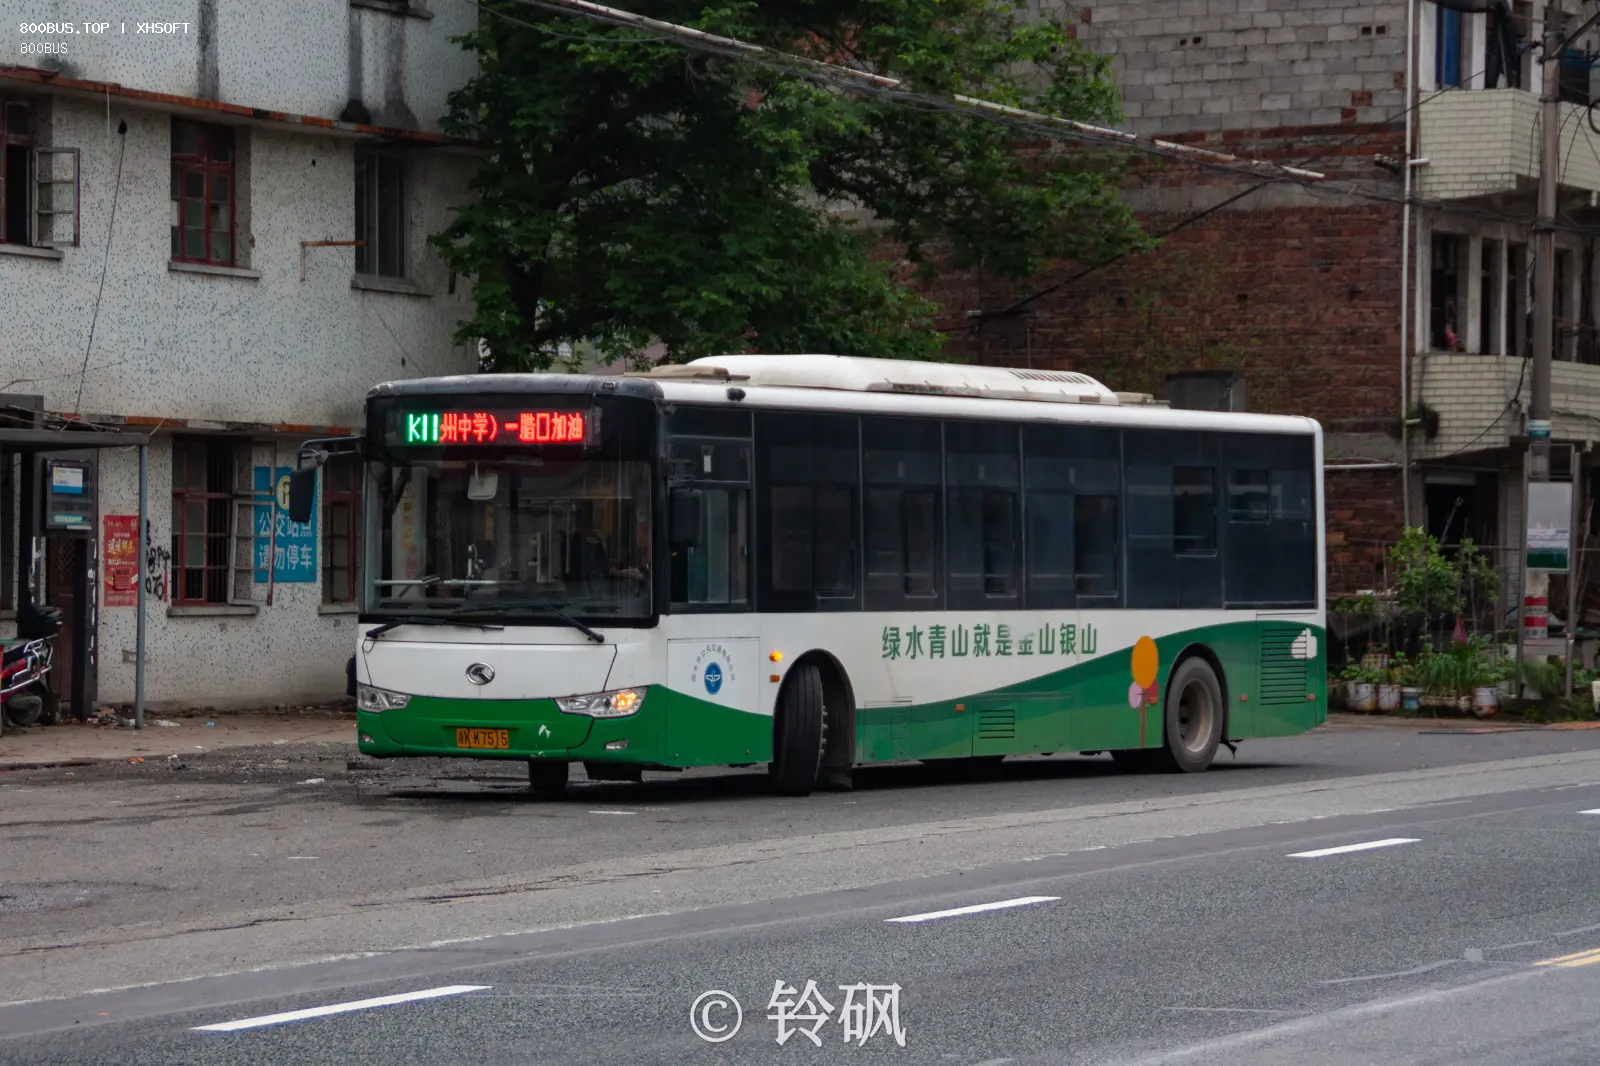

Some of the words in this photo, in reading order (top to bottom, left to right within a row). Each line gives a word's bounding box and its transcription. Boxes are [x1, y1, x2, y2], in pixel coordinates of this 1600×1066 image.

[408, 413, 438, 442] K11
[259, 511, 313, 538] 公交站点
[259, 544, 313, 571] 请勿停车
[881, 622, 1098, 661] 绿水青山就是金山银山
